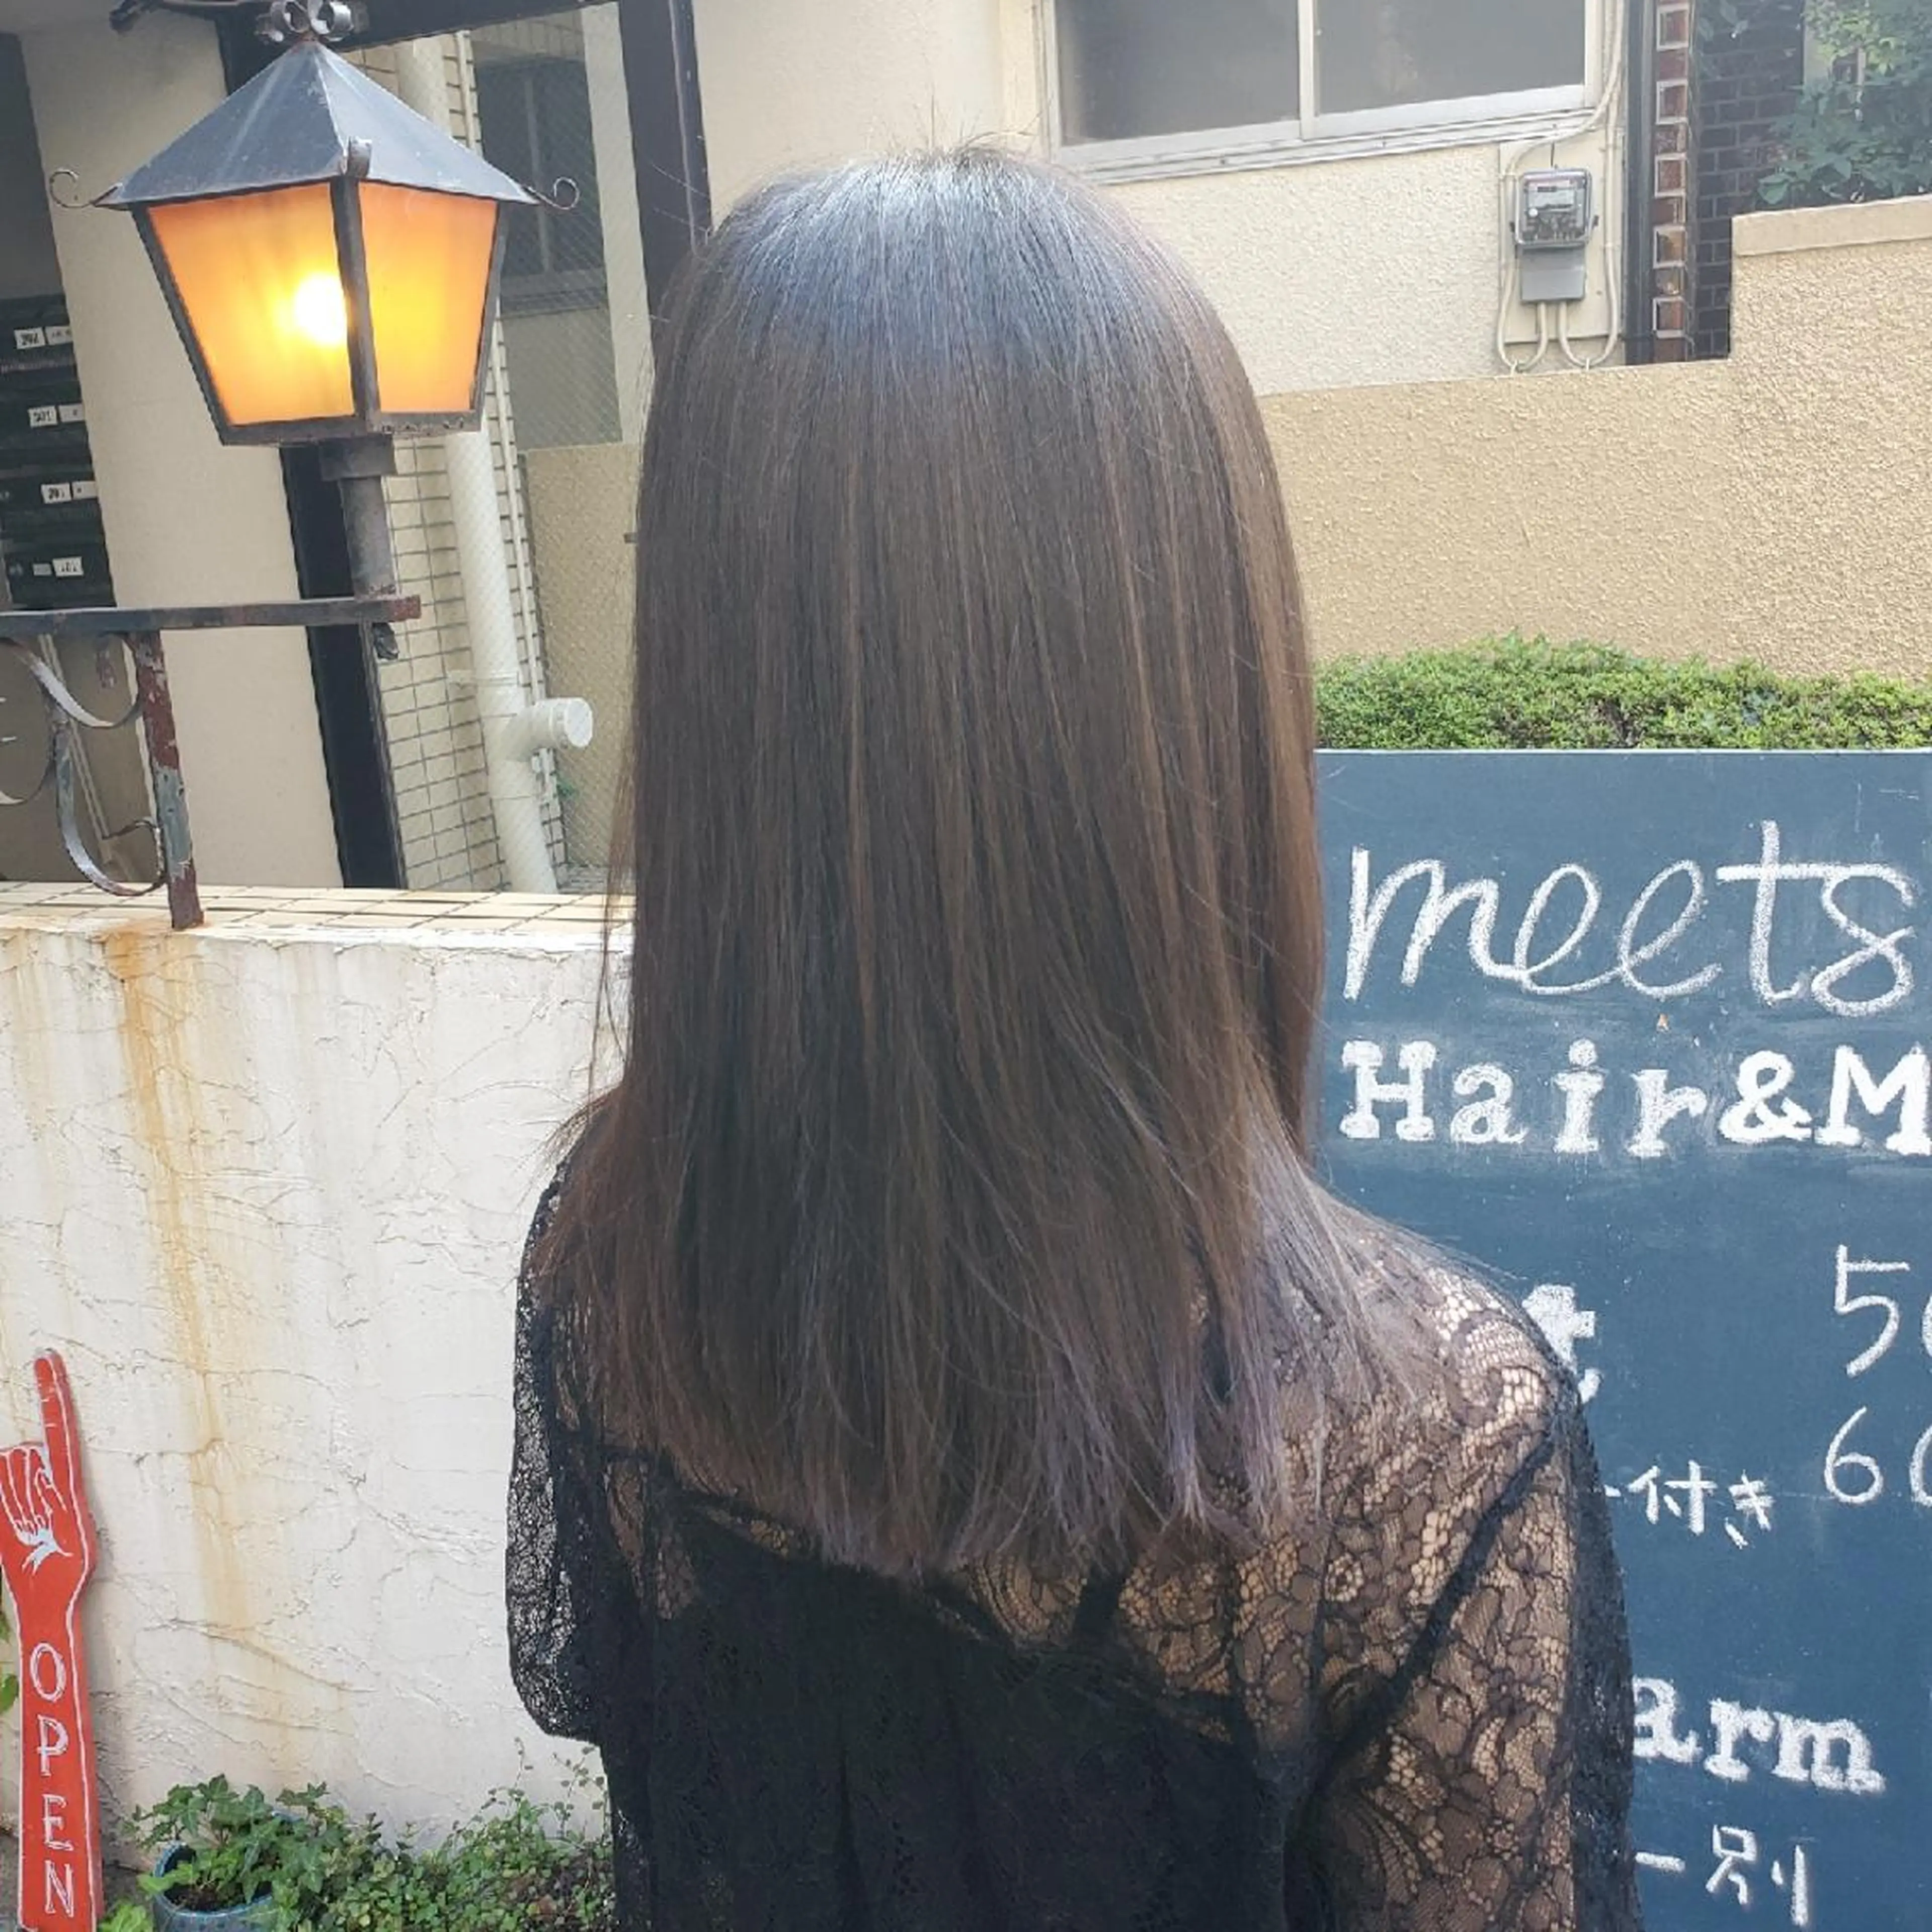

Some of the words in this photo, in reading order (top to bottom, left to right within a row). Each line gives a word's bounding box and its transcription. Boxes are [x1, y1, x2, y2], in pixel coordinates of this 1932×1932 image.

[1343, 820, 1915, 1017] meets
[1834, 1244, 1932, 1377] 5
[30, 1642, 75, 1918] OPEN
